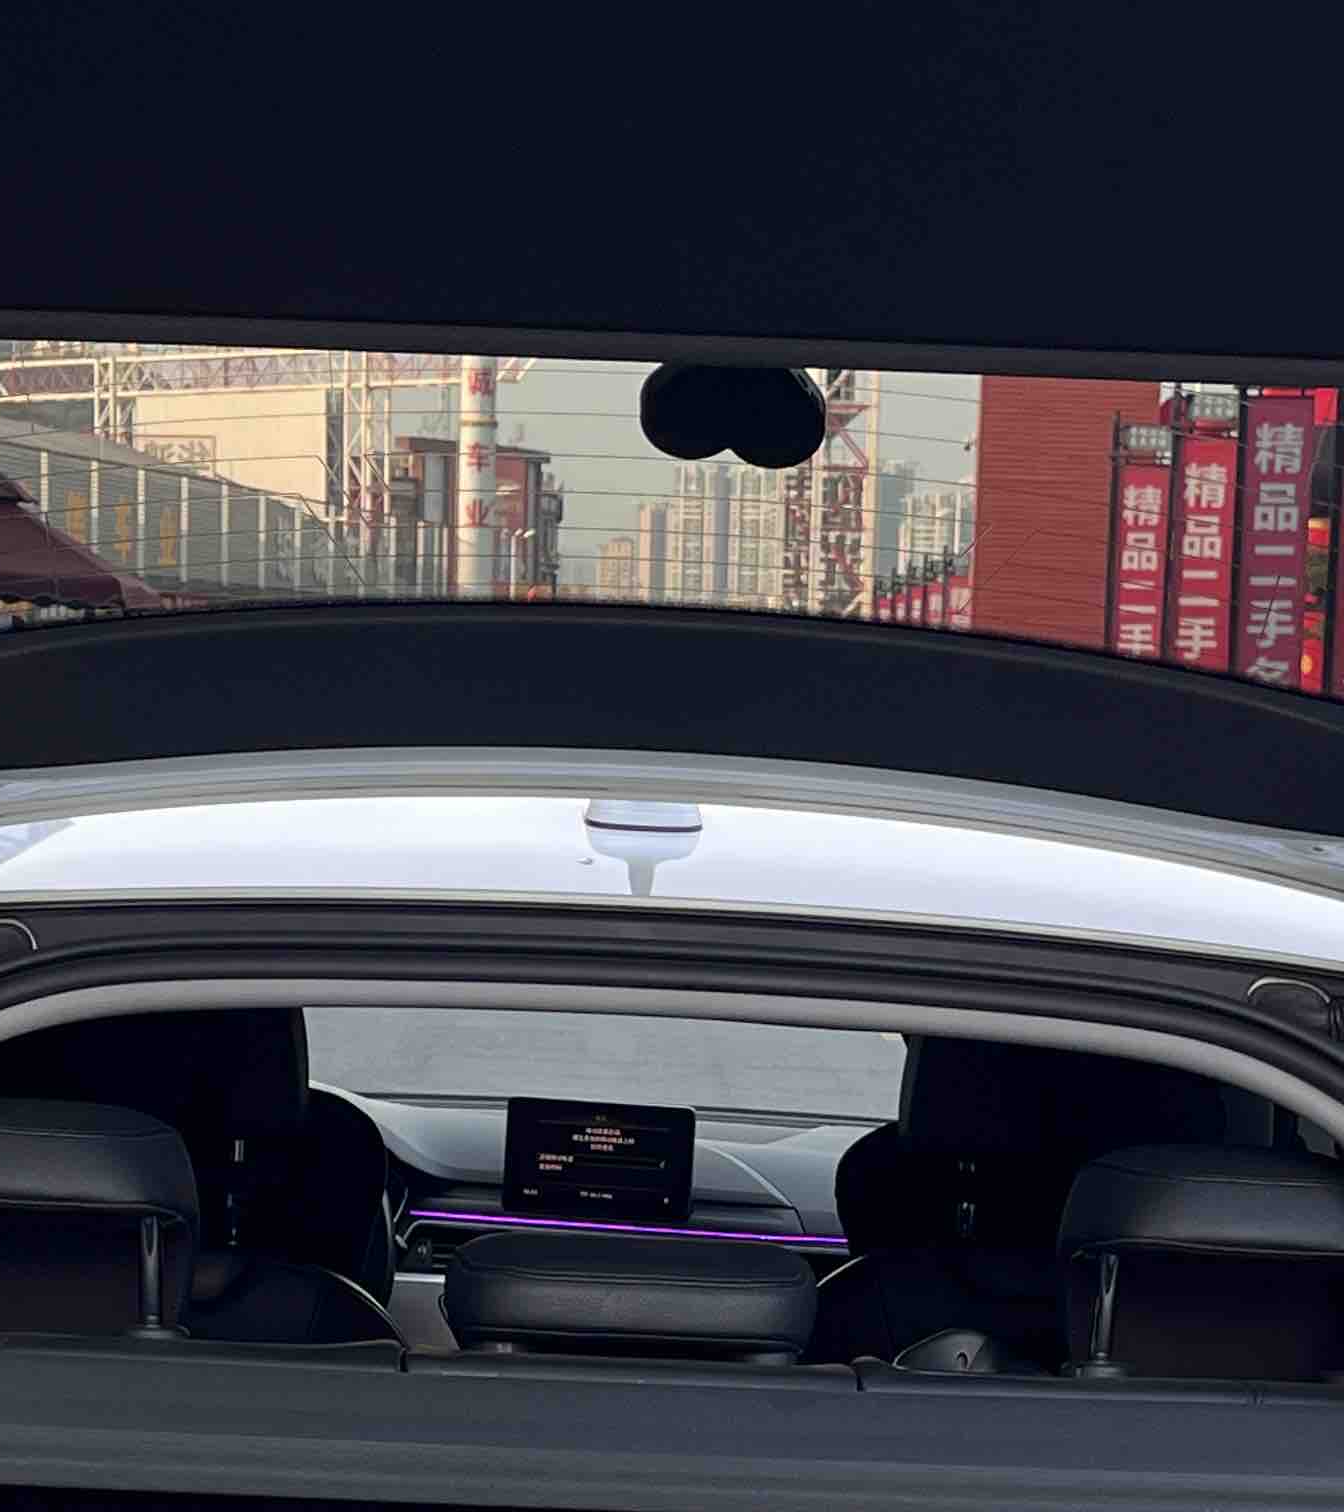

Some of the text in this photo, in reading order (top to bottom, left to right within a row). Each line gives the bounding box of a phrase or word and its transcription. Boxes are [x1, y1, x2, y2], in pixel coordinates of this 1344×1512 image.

[1117, 484, 1163, 657] 精品二手
[1175, 462, 1229, 662] 精品二手
